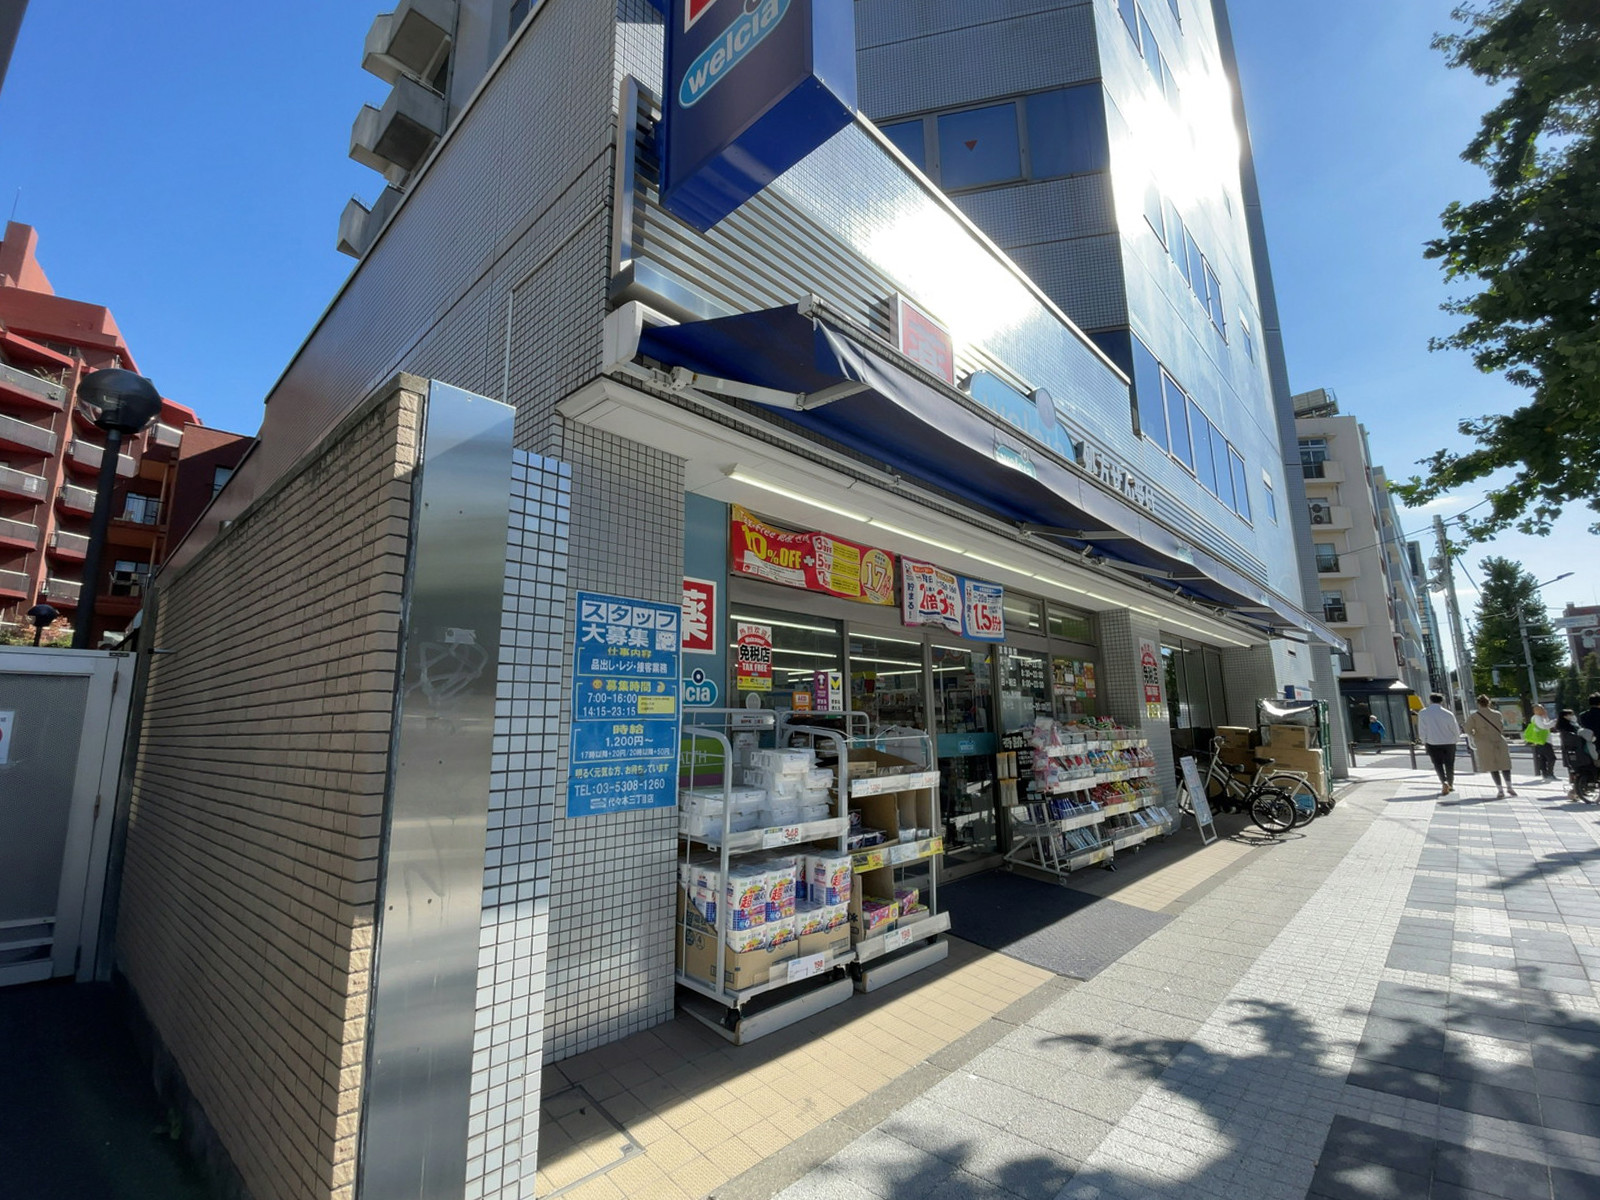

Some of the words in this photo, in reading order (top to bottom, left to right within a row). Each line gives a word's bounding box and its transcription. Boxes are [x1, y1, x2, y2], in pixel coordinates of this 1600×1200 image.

[688, 0, 780, 95] welcia
[582, 601, 676, 630] スタッフ
[581, 623, 649, 648] 大募集
[607, 647, 652, 659] 仕事内容
[740, 644, 771, 662] 免税店
[606, 679, 651, 693] 募集時間
[683, 682, 711, 702] lcia
[583, 706, 636, 717] 14:15-23:15
[612, 724, 644, 735] 時給
[608, 793, 655, 808] 代々木三丁目店
